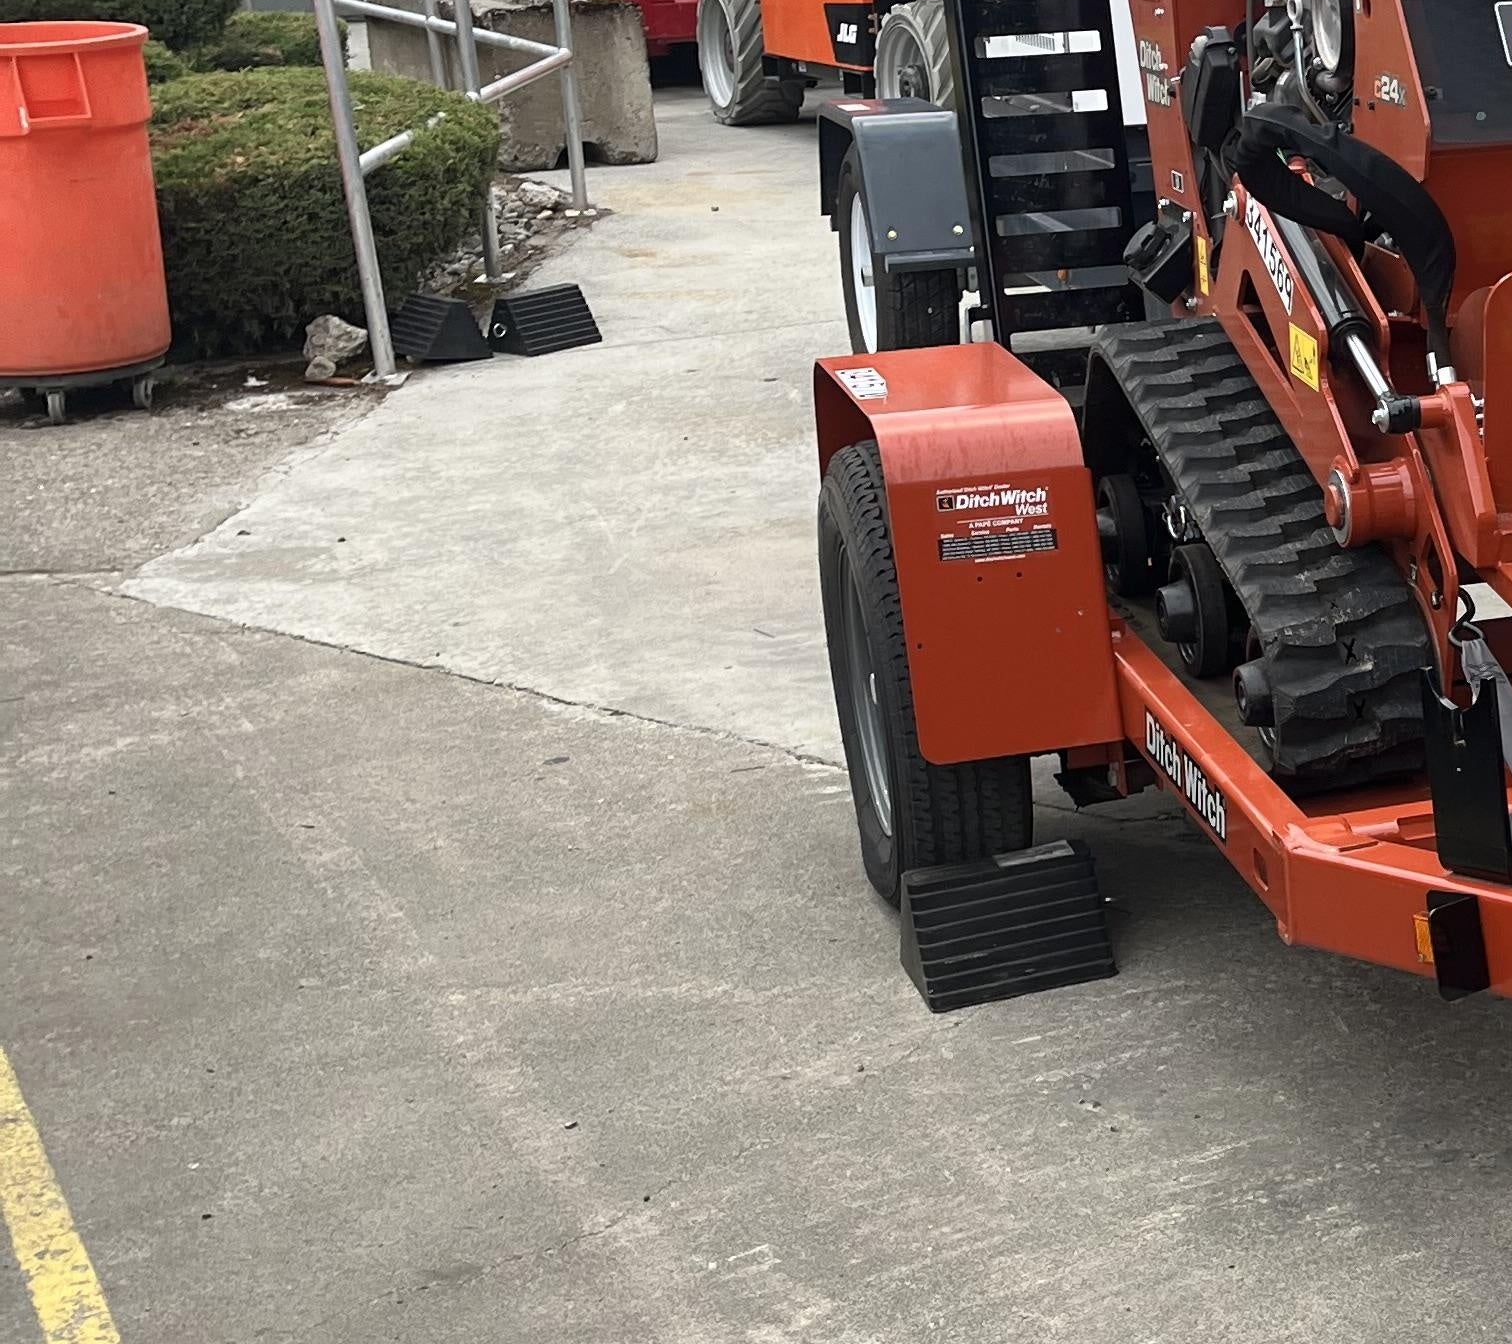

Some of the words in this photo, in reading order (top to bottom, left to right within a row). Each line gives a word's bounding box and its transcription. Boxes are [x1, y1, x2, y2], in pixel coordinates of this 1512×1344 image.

[1140, 40, 1161, 71] Ditch
[1147, 73, 1171, 106] Witch
[955, 492, 1000, 509] Ditch
[1001, 487, 1046, 505] Witch
[1015, 502, 1048, 516] West
[992, 518, 1024, 527] COMPANY
[1146, 711, 1181, 787] Ditch
[1183, 754, 1226, 839] Witch
